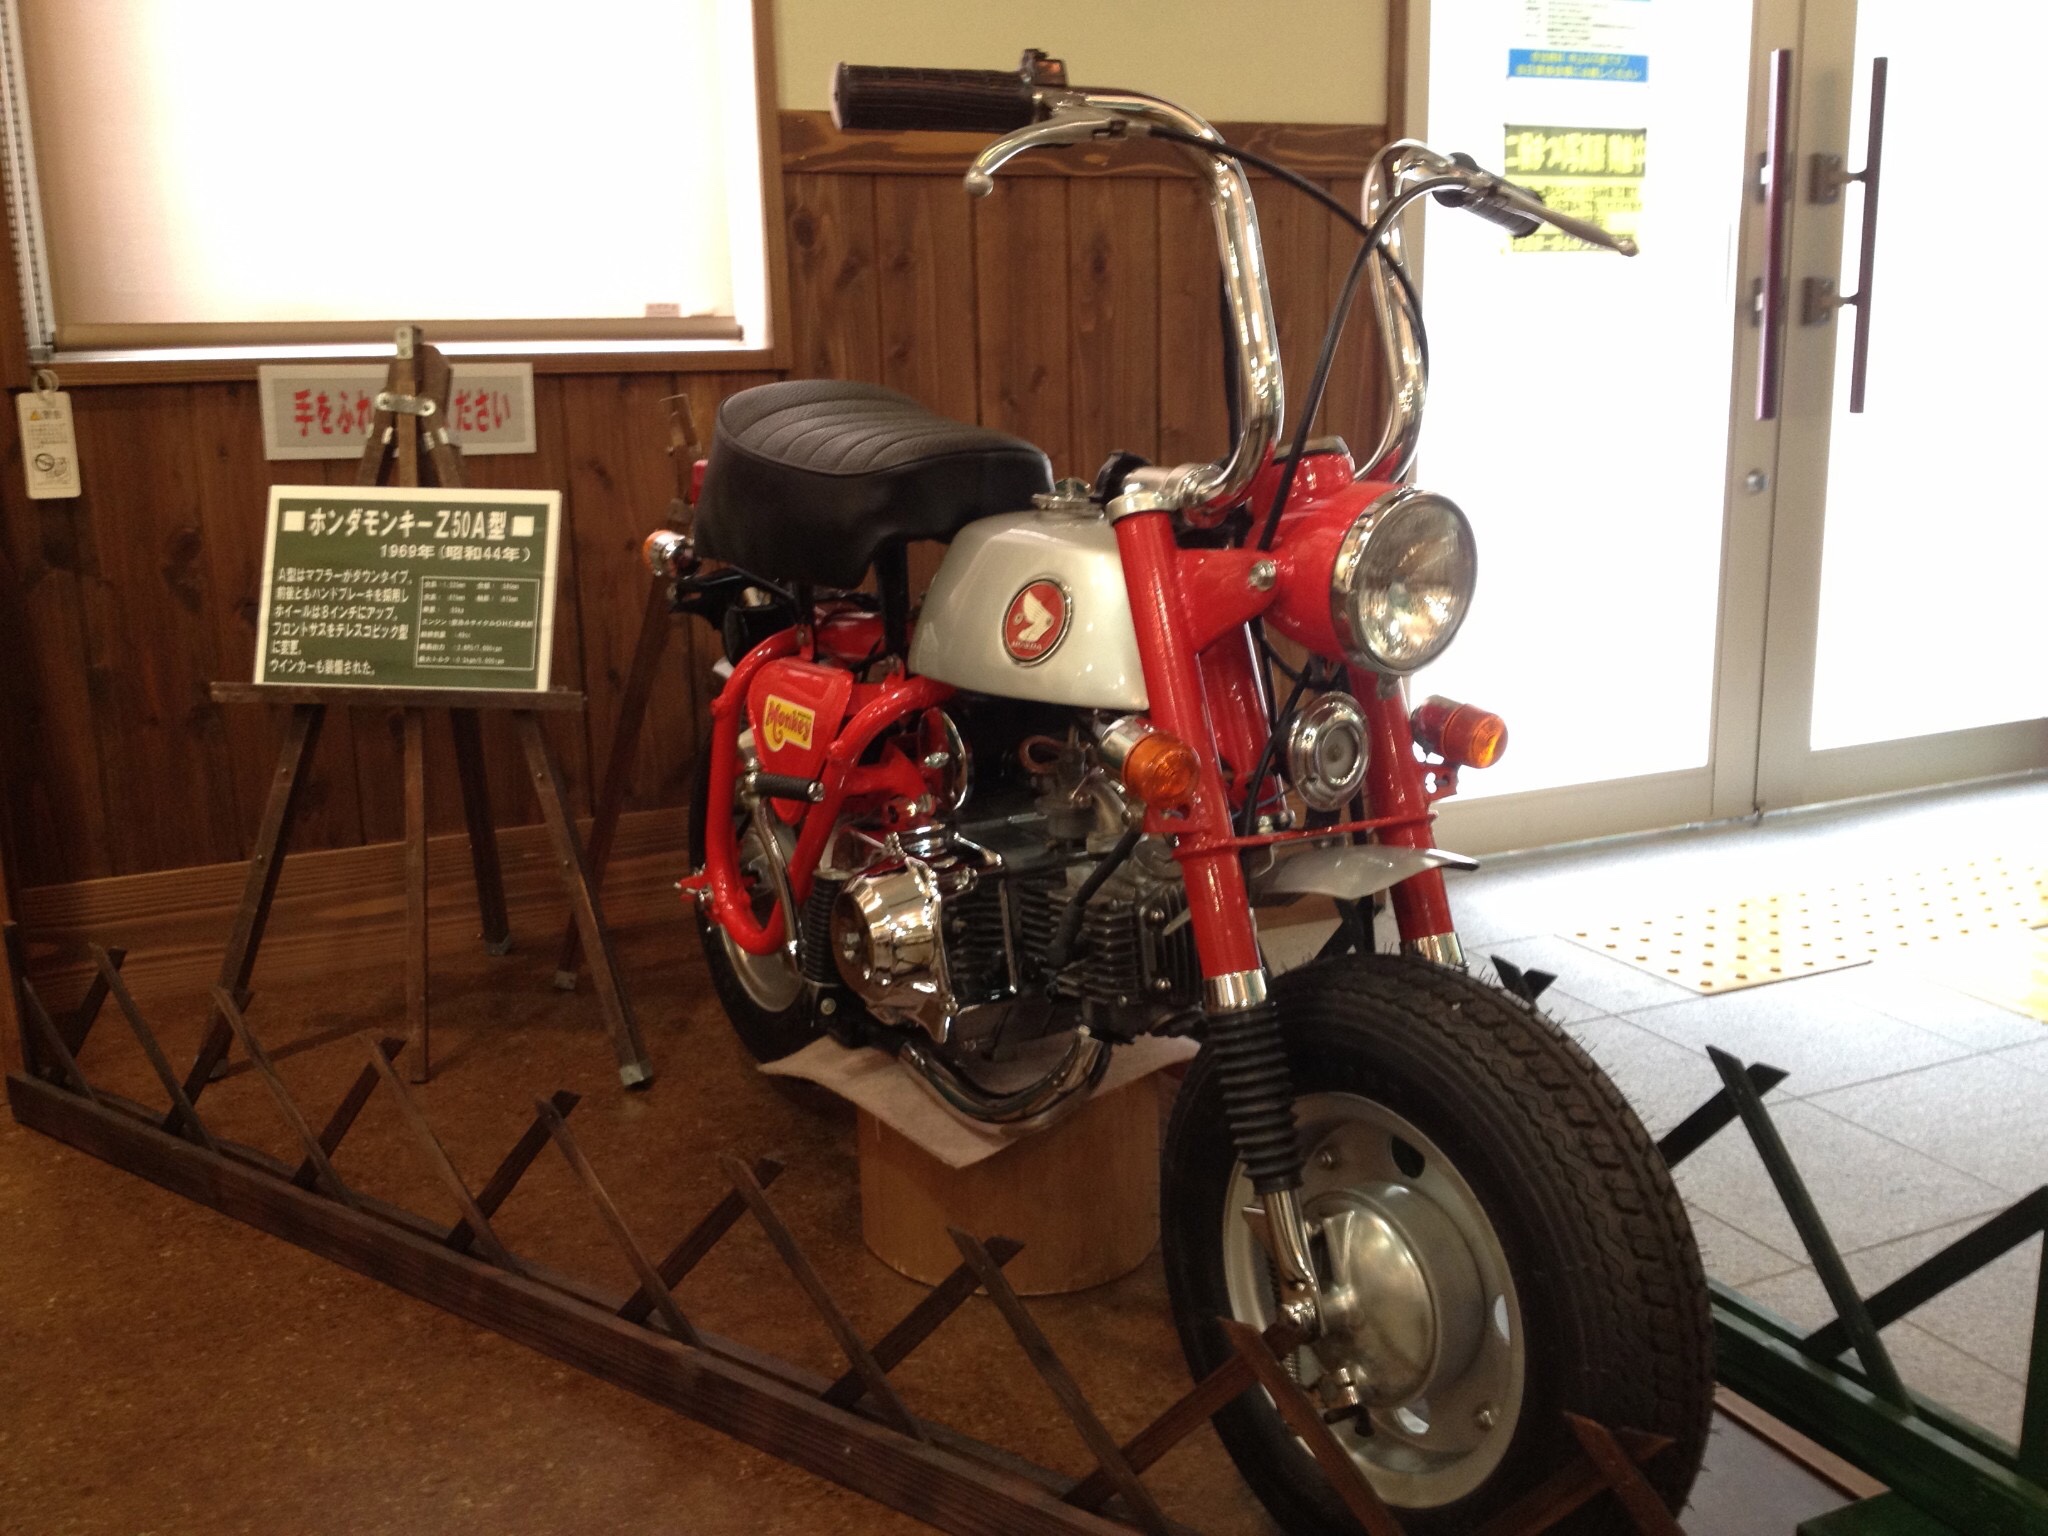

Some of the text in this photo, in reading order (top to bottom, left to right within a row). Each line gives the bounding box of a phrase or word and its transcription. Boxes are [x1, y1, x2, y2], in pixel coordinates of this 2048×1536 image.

[308, 507, 507, 540] ホンダモンキーZ50A型
[765, 699, 813, 745] Monkey
